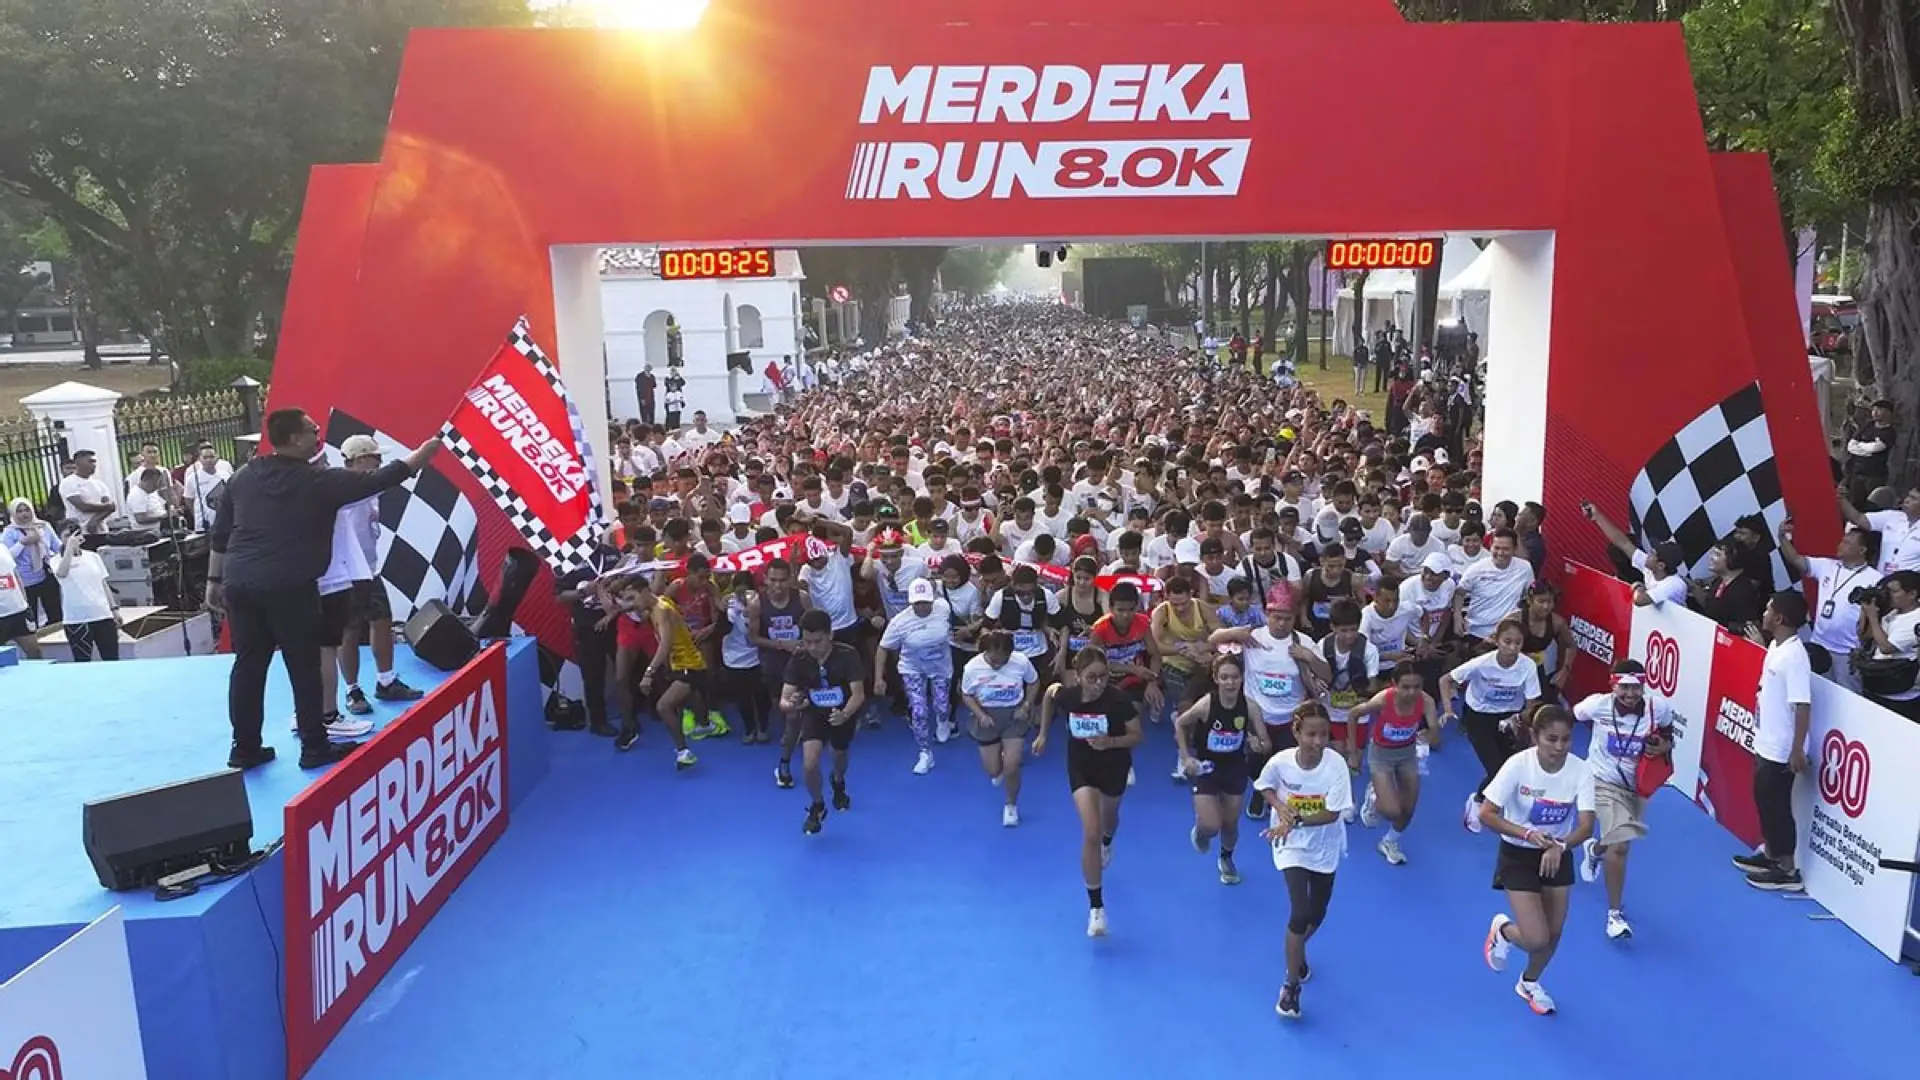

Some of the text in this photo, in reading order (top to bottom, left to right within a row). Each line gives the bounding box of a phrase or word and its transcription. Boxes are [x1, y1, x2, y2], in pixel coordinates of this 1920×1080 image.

[859, 63, 1251, 124] MERDEKA
[879, 141, 1043, 200] RUN
[664, 250, 769, 276] 00:09:25
[1331, 242, 1433, 266] 00:00:00
[473, 393, 529, 449] RUN
[483, 374, 587, 491] MERDEKA
[1570, 614, 1614, 650] MERDEKA
[1645, 629, 1680, 698] 80
[1720, 696, 1755, 730] MERD
[308, 679, 500, 920] MERDEKA
[1818, 728, 1871, 819] 80
[1811, 821, 1875, 875] Rakyat Sejahtera
[1814, 805, 1882, 860] Bersatu Berdaulat
[1809, 836, 1865, 886] Indonesia Maju
[334, 828, 427, 995] RUN
